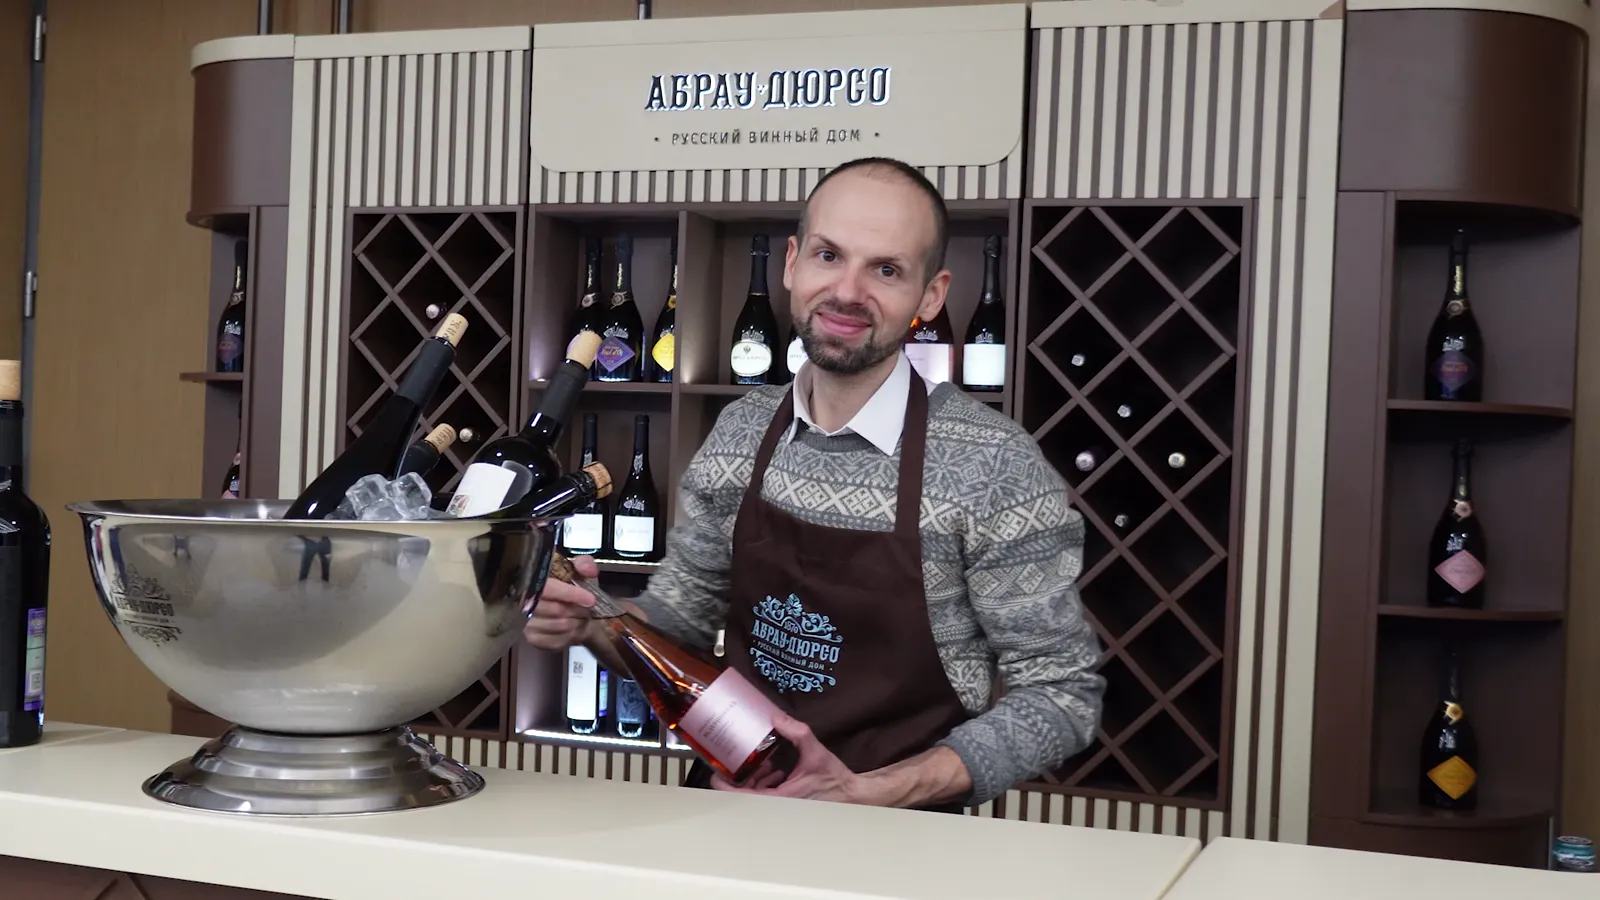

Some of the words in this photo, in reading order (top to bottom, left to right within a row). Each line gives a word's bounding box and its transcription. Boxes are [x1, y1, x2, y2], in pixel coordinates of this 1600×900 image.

[644, 72, 757, 111] АБРАУ
[763, 67, 892, 110] ДЮРСО
[672, 128, 741, 145] РУССКИЙ
[749, 127, 819, 144] ВИННЫЙ
[826, 129, 861, 144] ДОМ
[751, 619, 788, 649] АБРАУ
[787, 636, 840, 663] ДЮРСО
[808, 661, 825, 671] ДОМ
